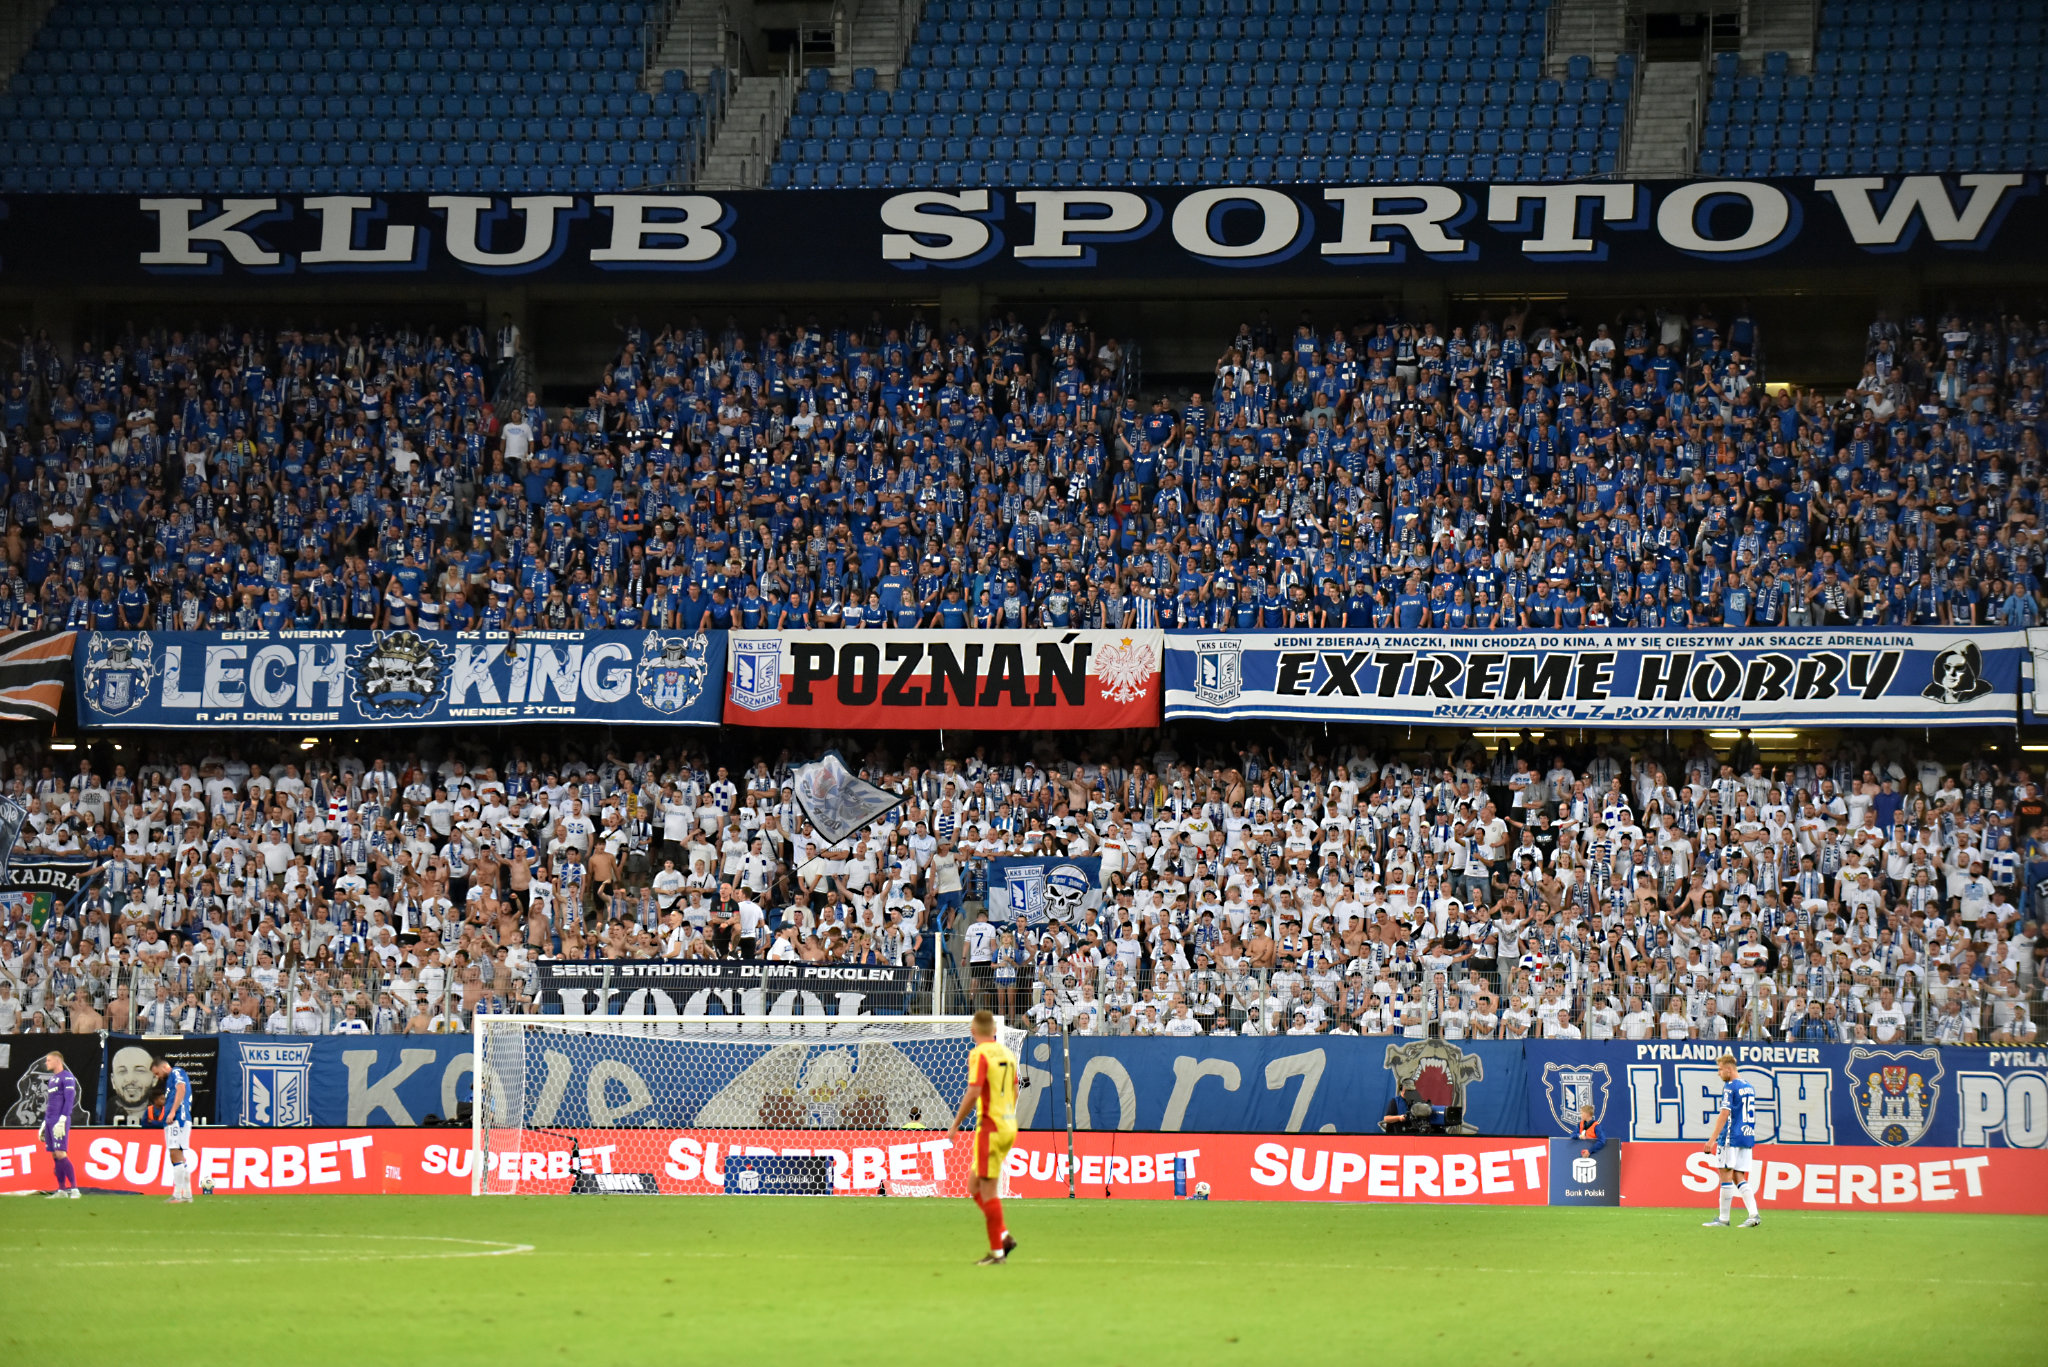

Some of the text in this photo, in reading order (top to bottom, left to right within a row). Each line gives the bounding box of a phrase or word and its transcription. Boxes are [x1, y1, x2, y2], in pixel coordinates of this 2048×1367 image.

[140, 173, 2048, 265] KLUB SPORTOW
[279, 630, 346, 640] WIERNY
[485, 631, 510, 640] DO
[1274, 636, 1914, 650] JEDNI ZBIERAJĄ ZNACZKI, INNI CHODZĄ DO KINA, A MY SIĘ CIESZYMY JAK SKACZE ADRENALINA
[738, 642, 778, 652] KKS LECH
[1201, 641, 1238, 650] KKS LECH
[161, 642, 633, 708] LECH KING
[786, 632, 1092, 707] POZNAŃ
[1274, 650, 1903, 702] EXTREME HOBBY
[196, 704, 576, 721] A JA DAM TOBIE WIENIEC ŻYCIA
[1432, 704, 1742, 720] RYZYKANCI Z POZNANIA
[1009, 869, 1040, 877] KKS LECH
[975, 932, 984, 948] 7
[621, 964, 721, 977] STADIONU
[248, 1048, 304, 1062] KKS LECH
[1636, 1044, 1820, 1064] PYRLANDIA FOREVER
[1741, 1095, 1756, 1123] 15
[170, 1126, 179, 1137] 16
[665, 1137, 954, 1190] SURBET
[1004, 1147, 1201, 1185] SUPERBET
[1249, 1142, 1547, 1198] SUPERBET
[891, 1180, 939, 1198] SUPERBET
[1565, 1188, 1605, 1197] Bank Polski
